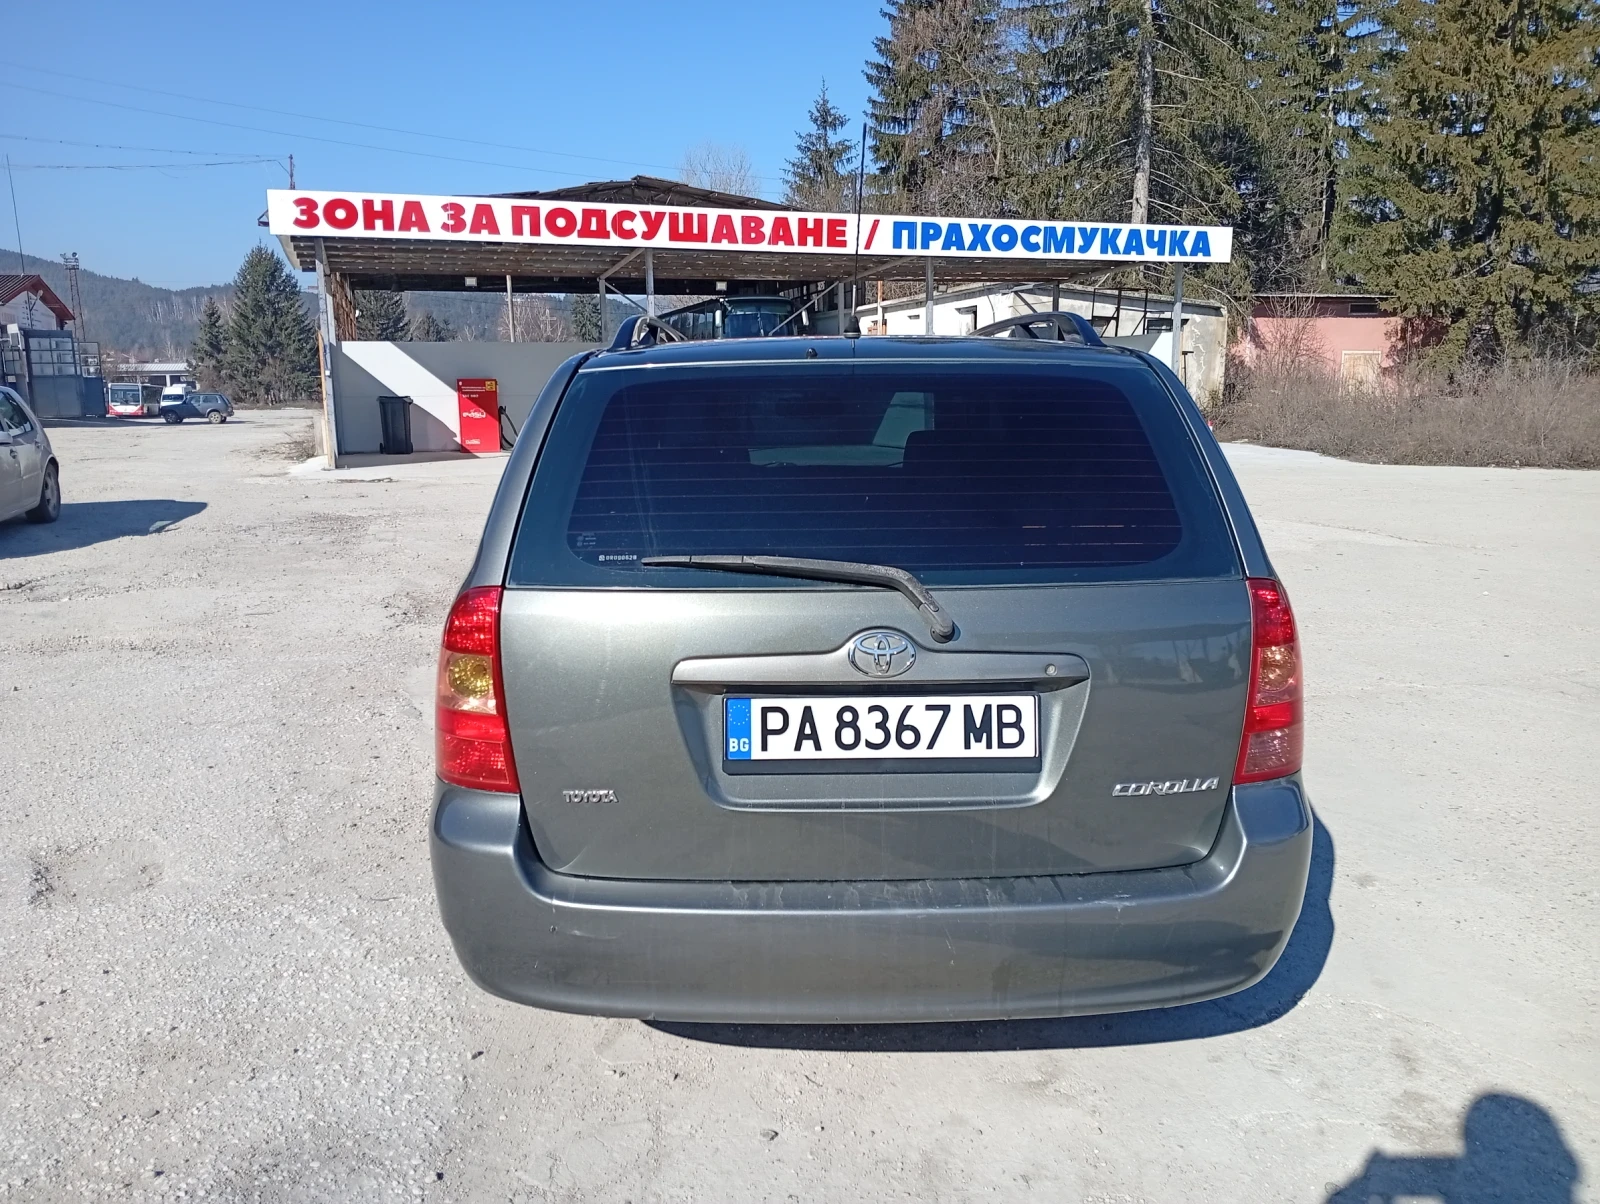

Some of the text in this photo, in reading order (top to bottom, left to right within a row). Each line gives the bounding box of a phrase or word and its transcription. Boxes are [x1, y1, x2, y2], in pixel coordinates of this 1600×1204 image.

[294, 198, 1210, 256] ЗОНА ЗА ПОДСУШАВАНЕ / ПРАХОСМУКАЧКА
[761, 704, 1024, 751] PA 8367 MB
[729, 738, 749, 752] BG
[562, 789, 619, 804] TOYOTA
[1112, 776, 1220, 797] COROLLA
